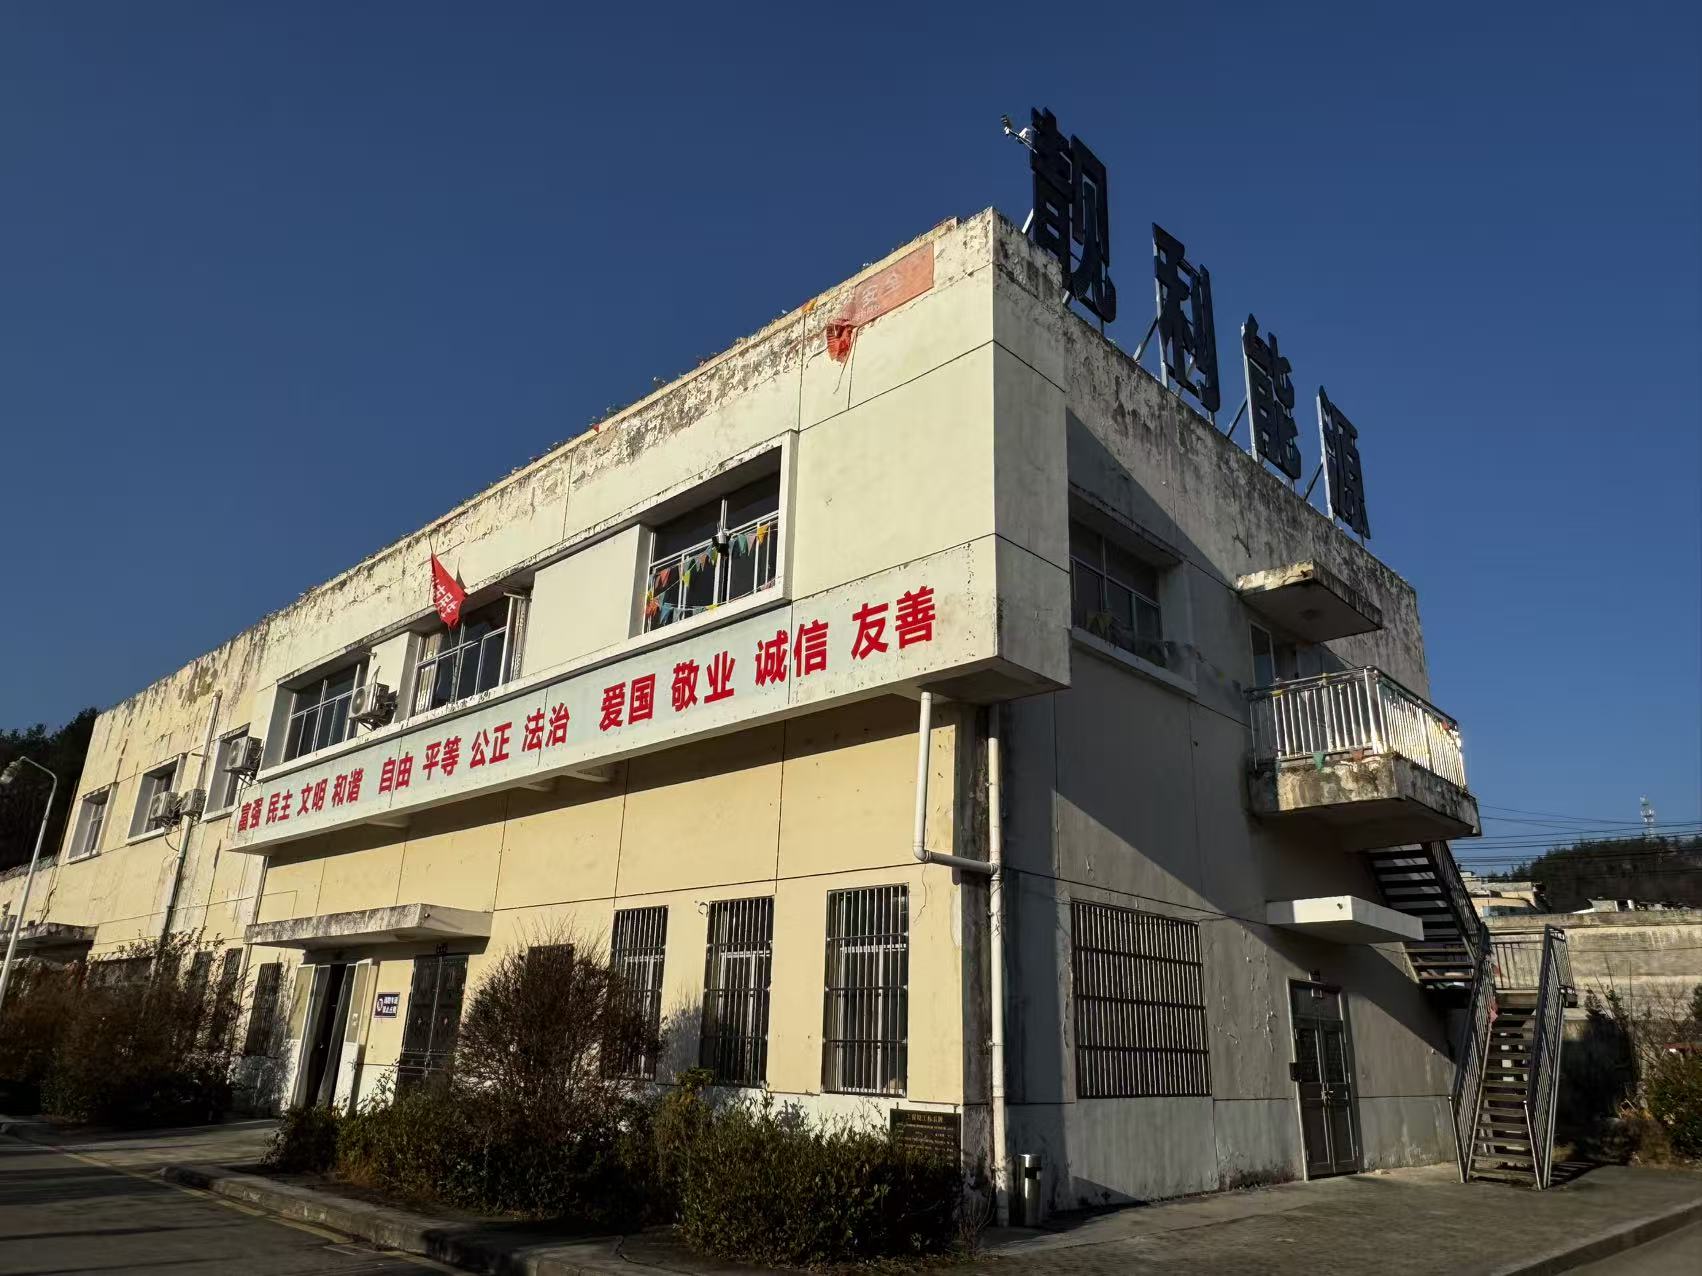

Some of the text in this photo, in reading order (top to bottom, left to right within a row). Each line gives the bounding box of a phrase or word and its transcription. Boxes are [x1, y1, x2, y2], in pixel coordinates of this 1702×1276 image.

[239, 586, 937, 832] 富强 民主 文明 和谐 自由 平等 公正 法治 爱国 敬业 诚信 友善
